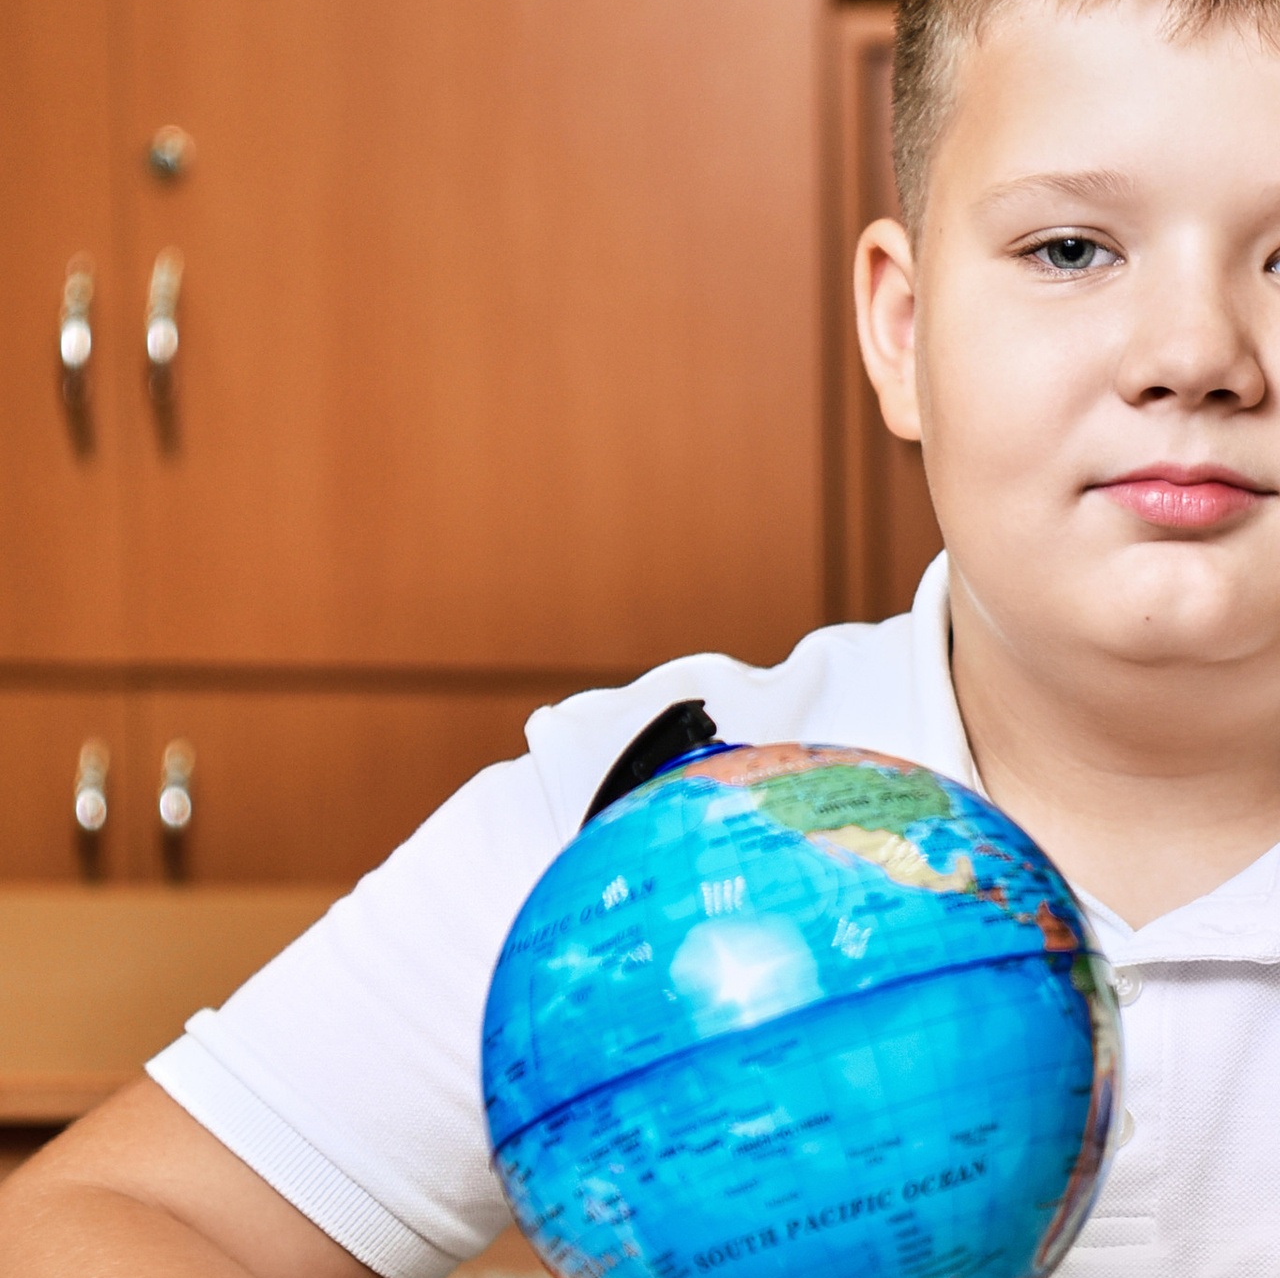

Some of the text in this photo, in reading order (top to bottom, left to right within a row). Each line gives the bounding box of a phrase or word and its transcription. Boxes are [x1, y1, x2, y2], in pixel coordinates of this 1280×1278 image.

[693, 1226, 779, 1273] SOUTH
[786, 1188, 894, 1240] PACIFIC
[900, 1155, 989, 1203] OCEAN
